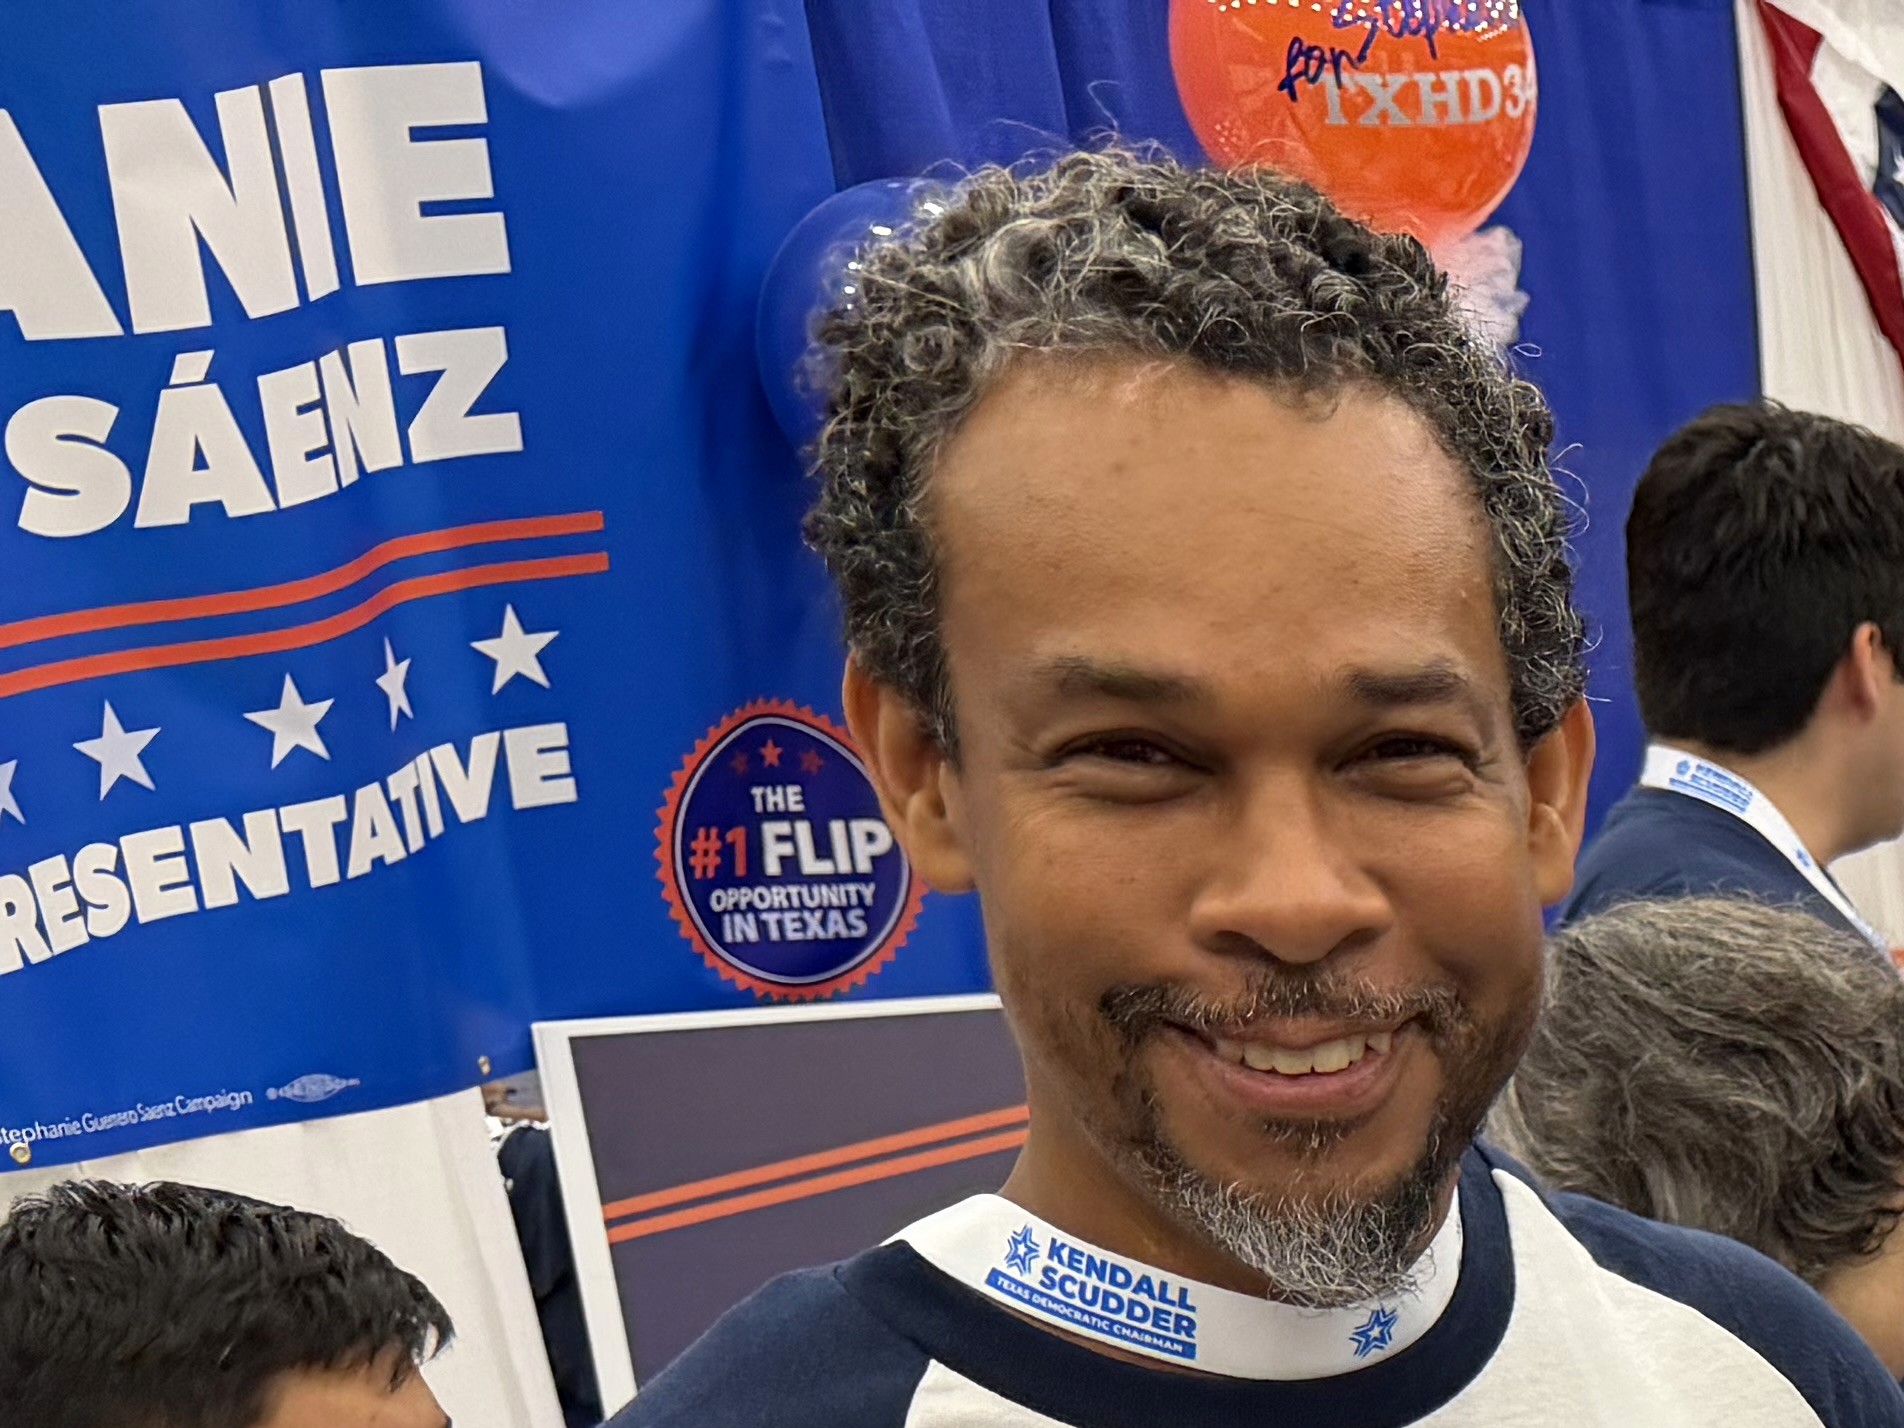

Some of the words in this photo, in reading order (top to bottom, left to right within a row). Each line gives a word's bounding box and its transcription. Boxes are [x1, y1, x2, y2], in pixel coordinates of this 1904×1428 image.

[5, 326, 523, 538] SÁENZ
[751, 784, 805, 813] THE
[0, 722, 578, 975] RESENTATIVE
[689, 826, 747, 879] #1
[761, 818, 893, 876] FLIP
[710, 882, 876, 912] OPPORTUNITY
[723, 912, 759, 943] IN
[761, 909, 867, 941] TEXAS
[175, 1088, 253, 1114] Campaign
[1039, 1265, 1197, 1339] SCUDDER
[1047, 1237, 1196, 1313] KENDALL
[997, 1276, 1030, 1300] TEXAS
[1032, 1293, 1109, 1331] DEMOCRATIC
[1113, 1324, 1183, 1353] CHAIRMAN
